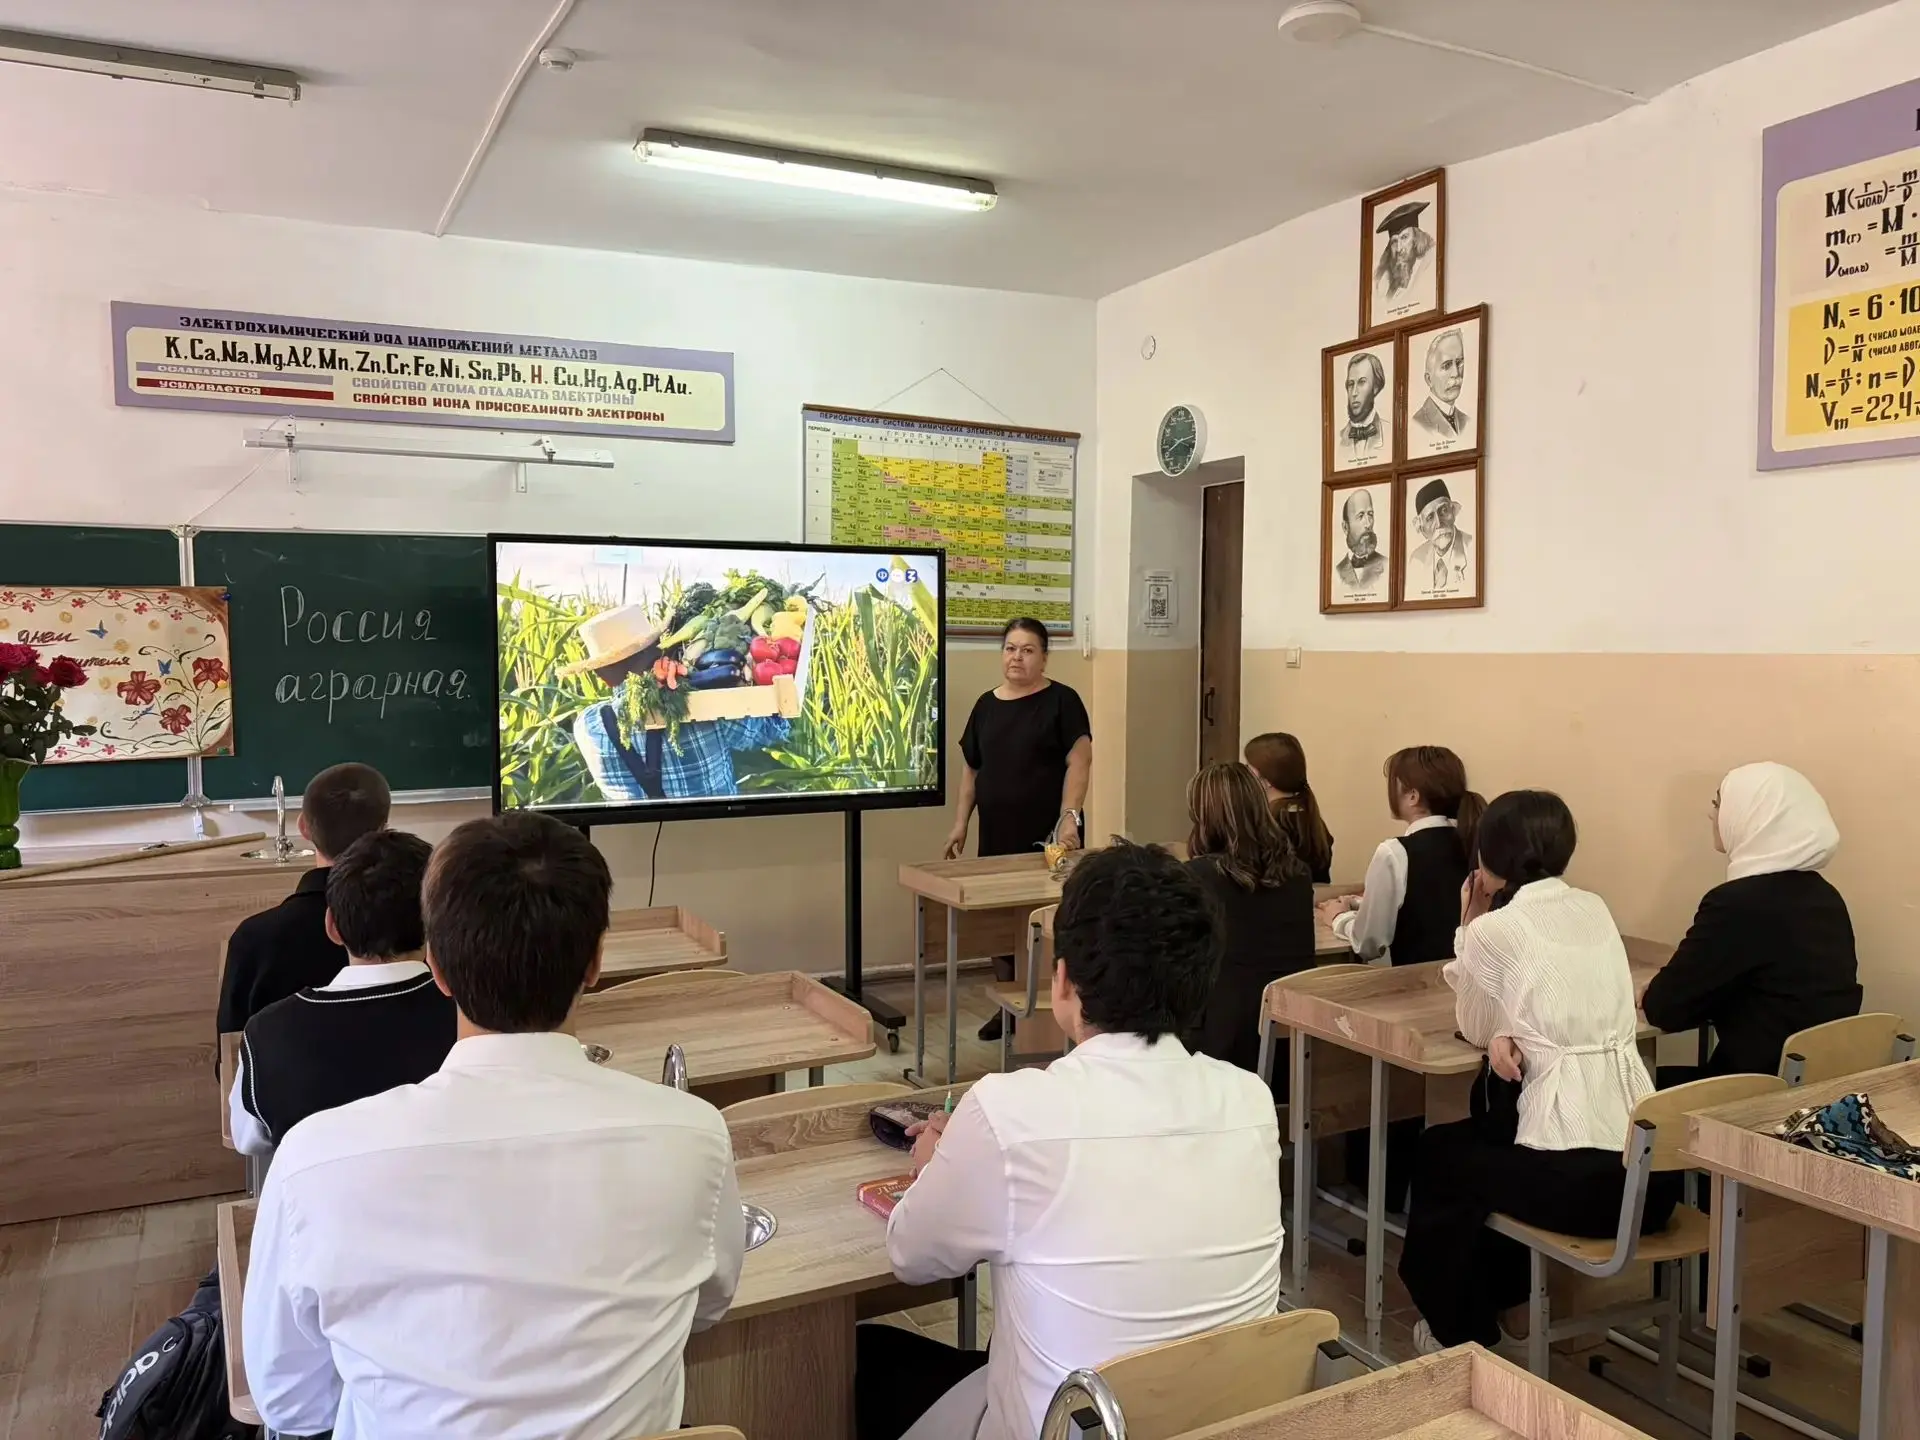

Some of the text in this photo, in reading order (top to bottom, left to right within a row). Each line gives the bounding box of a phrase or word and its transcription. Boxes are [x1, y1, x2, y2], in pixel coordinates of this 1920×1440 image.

[179, 316, 370, 343] ЭЛЕКТРОХИМИЧЕСКИЙ
[408, 335, 514, 354] НАПРЯЖЕНИЙ
[519, 344, 599, 361] МЕТАЛЛОВ
[352, 377, 635, 405] СВОЙСТВО АТОМА ОТДАВАТЬ ЭЛЕКТРОНЫ
[353, 392, 665, 421] СВОЙСТВО ИОНА ПРИСОЕДИНЯТЬ ЭЛЕКТРОНЫ
[819, 412, 880, 425] ПЕРИОДИЧЕСКАЯ
[882, 420, 915, 429] СИСТЕМА
[917, 423, 964, 433] ХИМИЧЕСКИХ
[966, 428, 1005, 437] ЭЛЕМЕНТОВ
[279, 585, 438, 646] Россия
[275, 667, 473, 724] аграрная.
